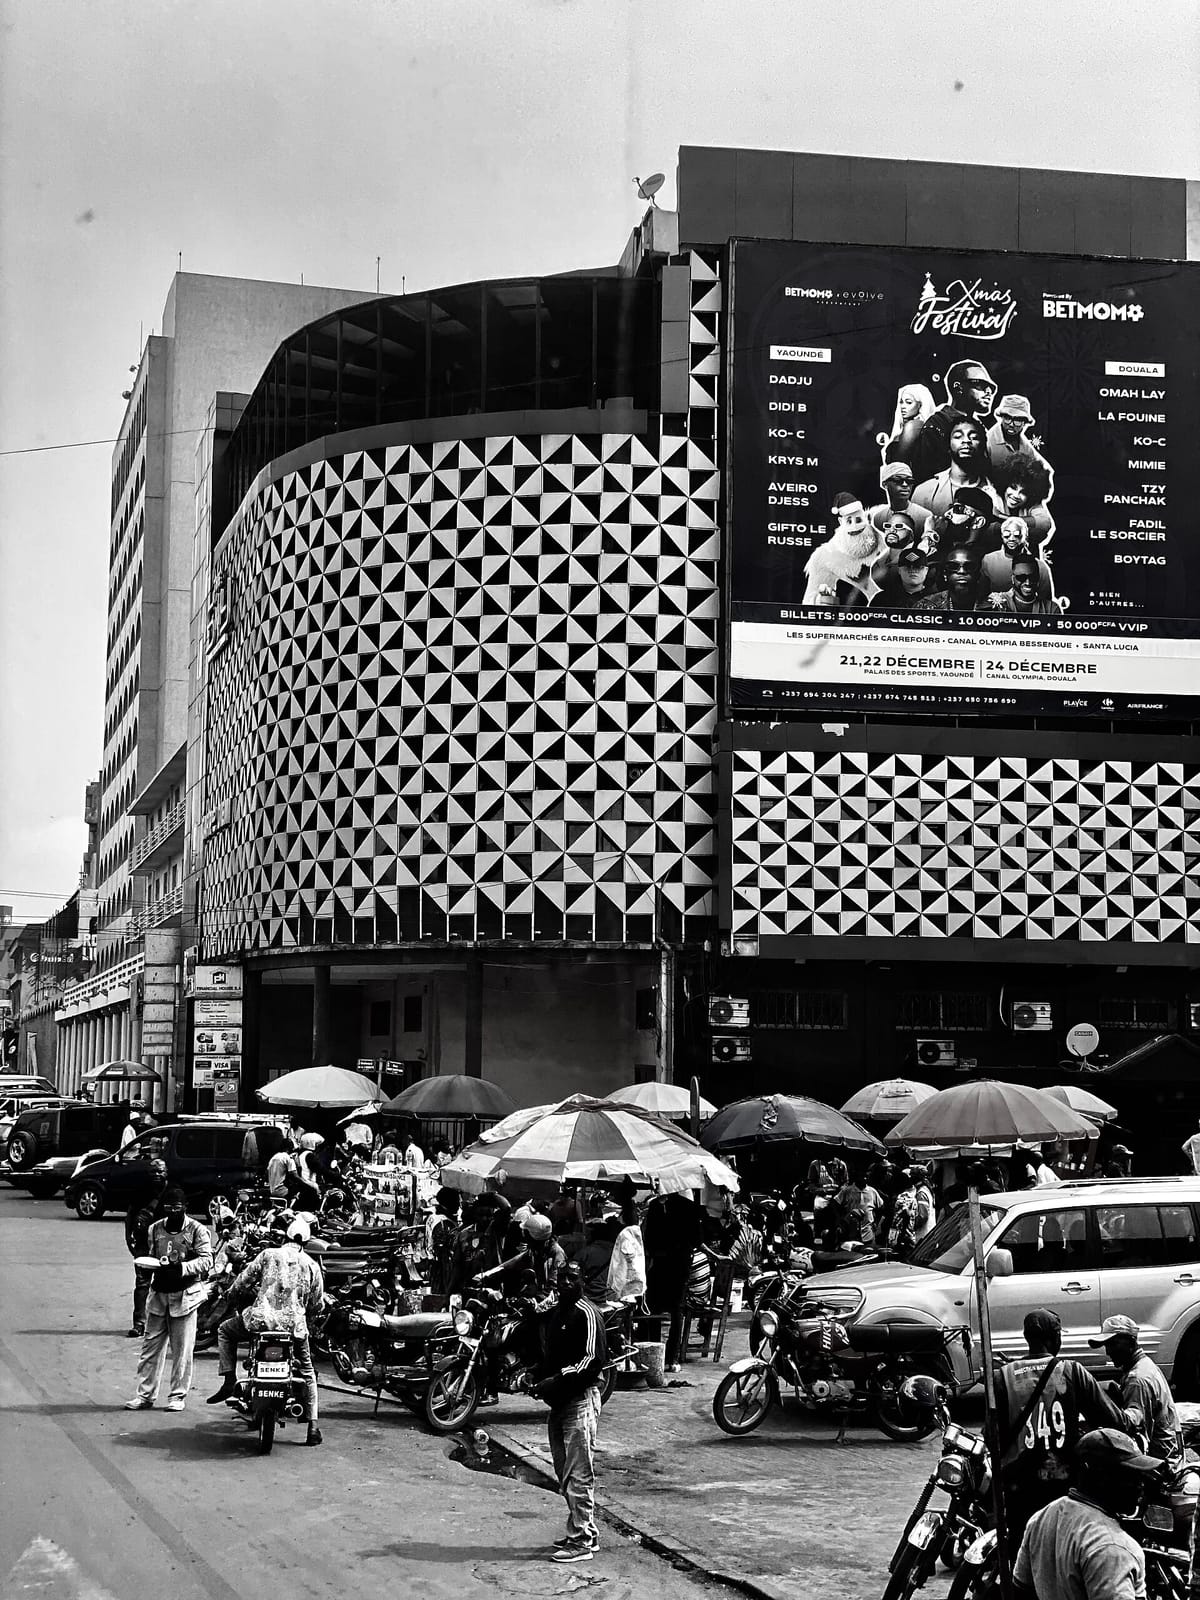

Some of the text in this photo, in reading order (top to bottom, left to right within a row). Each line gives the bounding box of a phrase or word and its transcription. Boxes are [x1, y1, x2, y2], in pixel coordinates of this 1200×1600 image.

[842, 291, 884, 300] evolve
[946, 278, 1012, 308] Xmas
[911, 297, 1017, 340] Festival
[769, 375, 812, 385] DADJU
[1100, 388, 1166, 399] OMAH LAY
[769, 402, 806, 412] DIDI B
[1098, 411, 1165, 423] LA FOUINE
[1134, 437, 1166, 446] KO-C
[768, 456, 818, 466] KRYS M
[1129, 460, 1166, 469] MIMIE
[768, 482, 817, 493] AVEIRO
[1142, 485, 1166, 493] TZY
[768, 496, 809, 506] DJESS
[1104, 495, 1166, 505] PANCHAK
[768, 523, 826, 533] GIFTO LE
[1129, 520, 1166, 529] FADIL
[1090, 530, 1166, 541] LE SORCIER
[768, 536, 812, 546] RUSSE
[1114, 555, 1166, 565] BOYTAG
[780, 610, 835, 621] BILLETS:
[890, 615, 943, 625] CLASSIC
[958, 617, 973, 626] 10
[1021, 619, 1041, 628] VIP
[1057, 621, 1072, 629] 50
[1119, 623, 1148, 632] VVIP
[806, 632, 878, 641] SUPERMARCHÉS
[881, 635, 940, 643] CARREFOURS
[948, 636, 977, 644] CANAL
[979, 639, 1017, 647] OLYMPIA
[1020, 641, 1072, 649] BESSENGUE
[840, 654, 1096, 674] 21,22 DÉCEMBRE 24 DÉCEMBRE
[258, 1390, 284, 1398] SENKE
